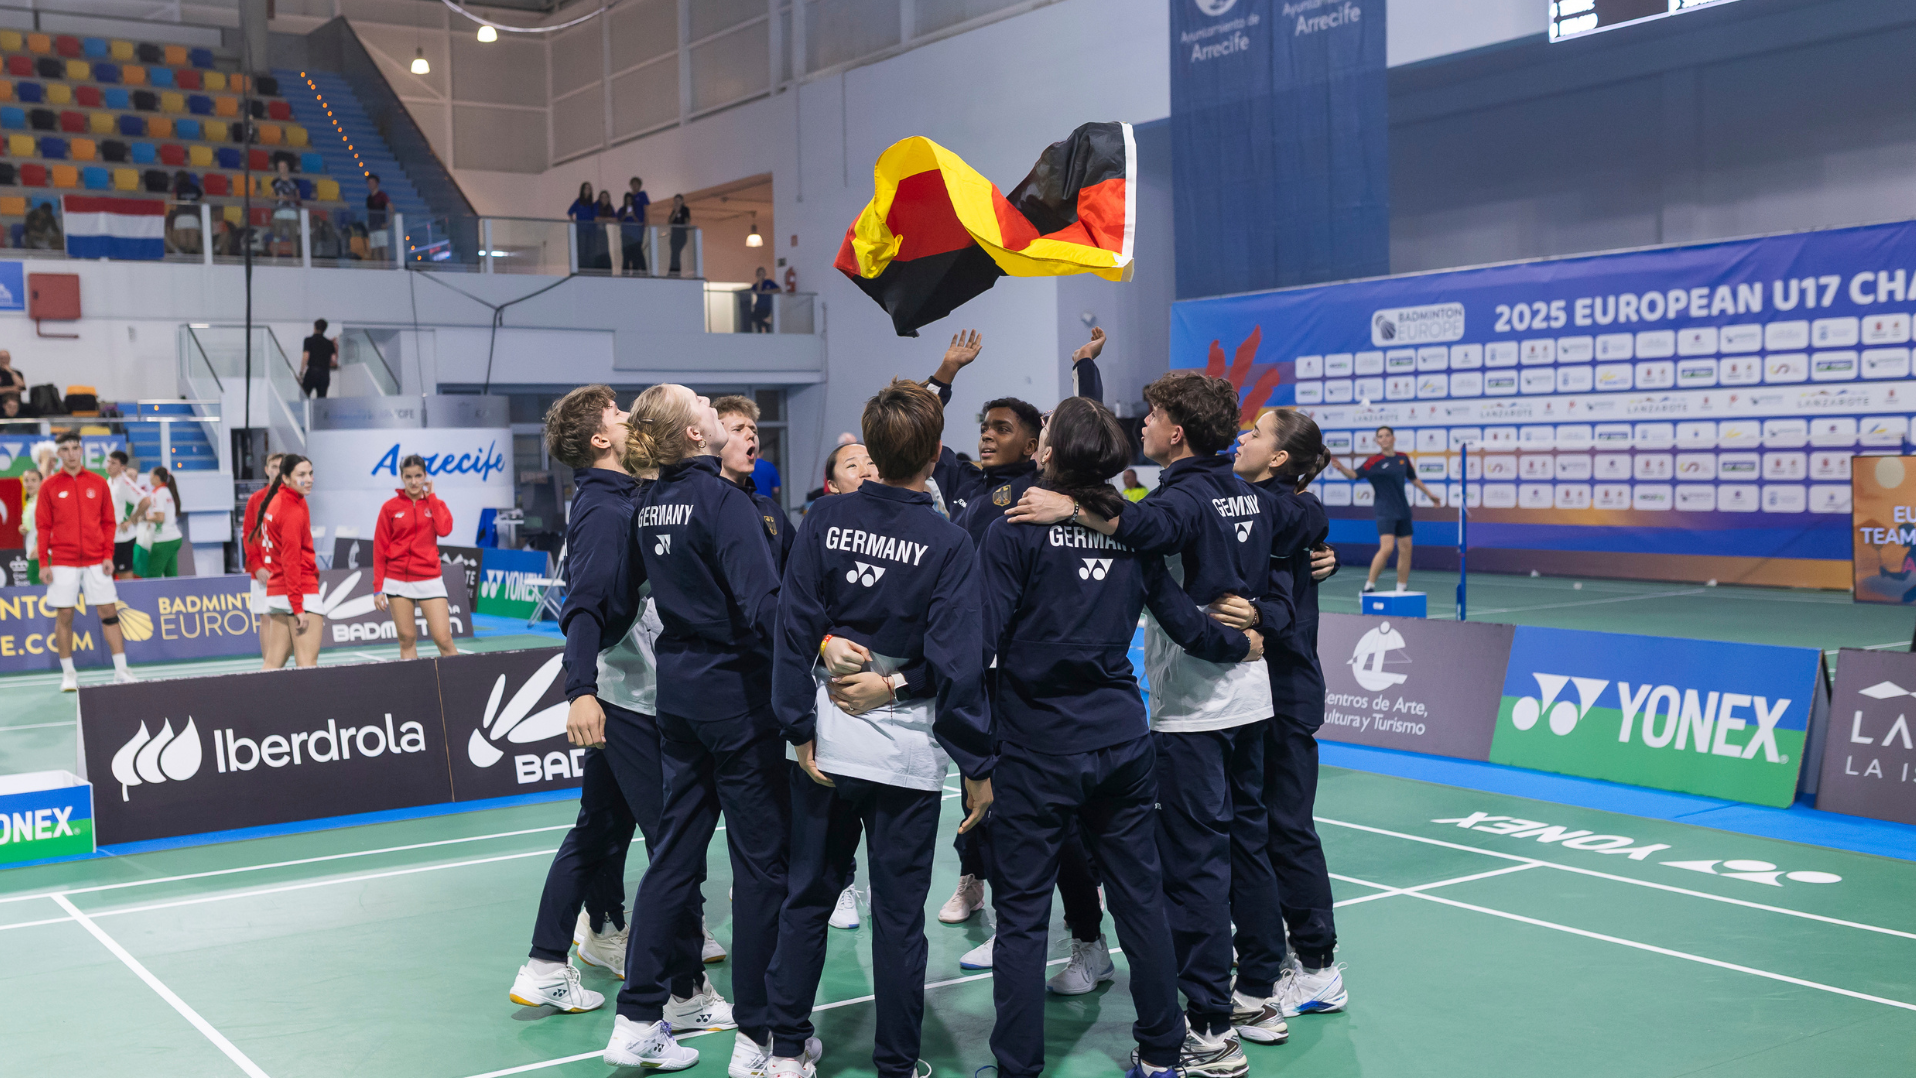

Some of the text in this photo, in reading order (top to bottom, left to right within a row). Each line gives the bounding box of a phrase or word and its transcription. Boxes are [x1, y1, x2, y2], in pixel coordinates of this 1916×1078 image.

[1294, 1, 1361, 36] Arrecife
[1190, 31, 1250, 63] Arrecife
[1398, 306, 1462, 322] BADMINTON
[1494, 299, 1567, 333] 2025
[1574, 282, 1763, 327] EUROPEAN
[1772, 274, 1842, 311] U17
[1398, 319, 1462, 340] EUROPE
[371, 439, 505, 482] Arecife
[638, 504, 694, 528] GERMANY
[825, 526, 928, 566] GERMANY
[1049, 525, 1135, 552] GERMA
[1325, 689, 1428, 718] entros de Arte,
[1323, 708, 1426, 735] ultura y Turismo
[1617, 681, 1792, 763] YONEX
[213, 712, 426, 773] Iberdrola
[1845, 755, 1883, 779] LA
[1430, 811, 1672, 861] YONEX
